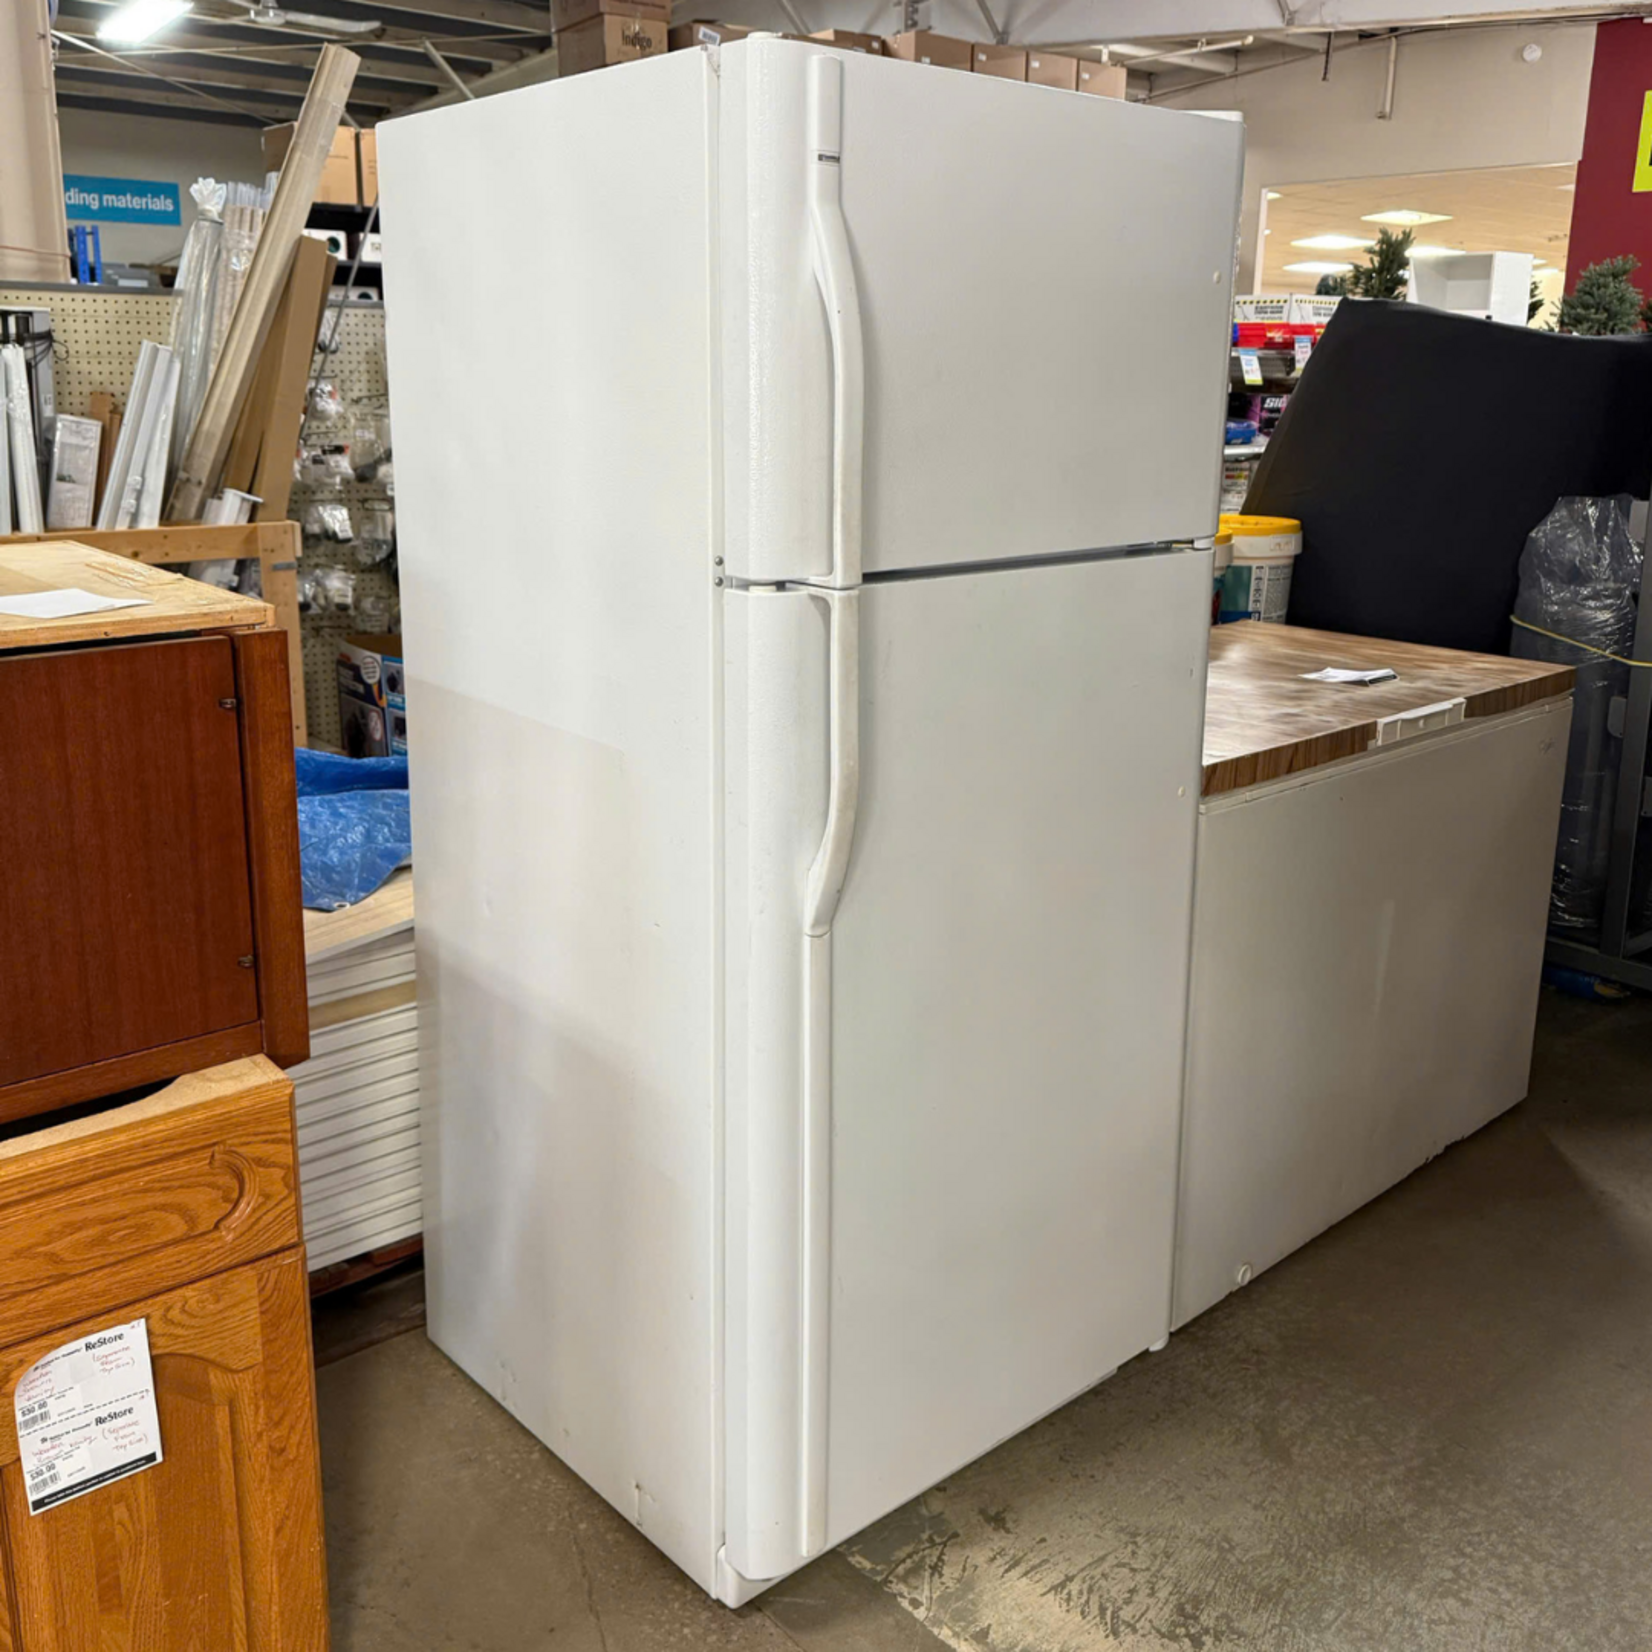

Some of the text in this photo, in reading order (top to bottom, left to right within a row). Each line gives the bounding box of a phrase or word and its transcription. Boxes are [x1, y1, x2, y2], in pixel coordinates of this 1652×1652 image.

[622, 29, 653, 51] Indigo
[102, 192, 174, 212] materials
[85, 1333, 124, 1352] ReStore
[21, 1400, 48, 1418] $30.00
[95, 1406, 134, 1427] ReStore
[30, 1463, 56, 1481] $30.00
